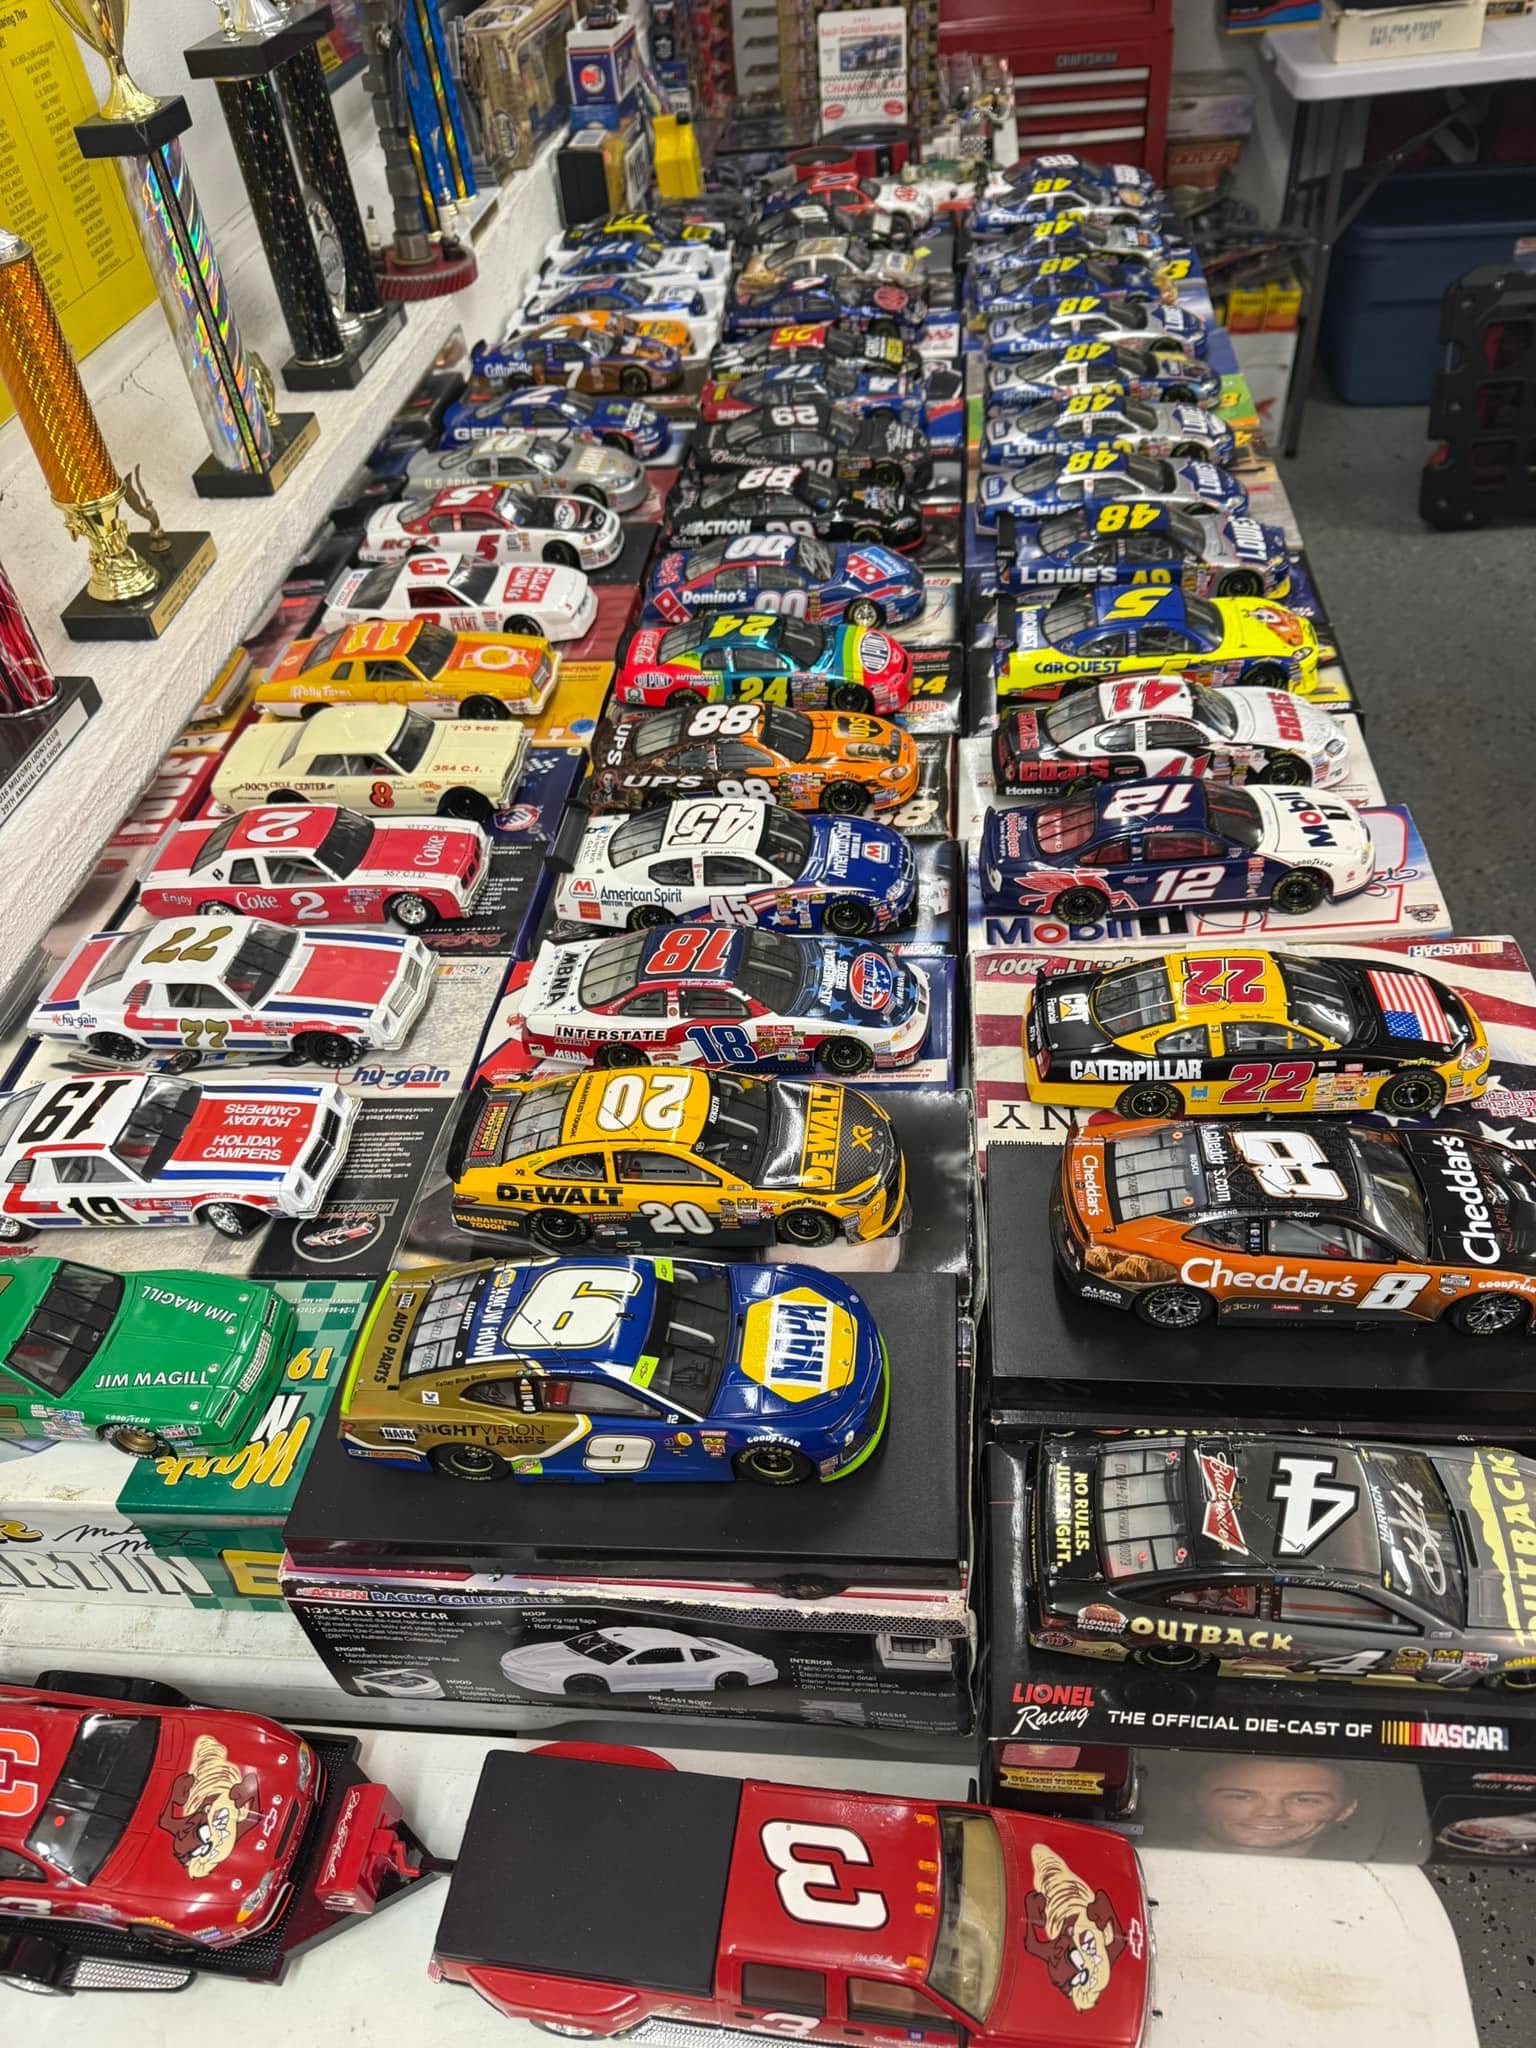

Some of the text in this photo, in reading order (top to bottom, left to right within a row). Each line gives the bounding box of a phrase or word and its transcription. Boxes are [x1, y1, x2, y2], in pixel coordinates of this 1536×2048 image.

[1032, 177, 1072, 194] 48
[1033, 219, 1076, 239] 48
[1038, 256, 1083, 276] 48
[1056, 296, 1102, 315] 48
[1063, 343, 1112, 363] 48
[563, 361, 585, 390] 7
[1066, 394, 1118, 414] 48
[1067, 451, 1121, 474] 48
[1095, 503, 1162, 533] 48
[475, 534, 501, 562] 5
[724, 534, 797, 559] 00
[1019, 566, 1118, 585] LOWE'S
[681, 590, 748, 604] Domino's
[1103, 587, 1173, 620] 5
[344, 621, 412, 654] 11
[707, 614, 778, 639] 24
[739, 677, 789, 708] 24
[1110, 678, 1182, 716] 41
[687, 704, 761, 737] 88
[7, 727, 60, 790] MILFORD LIONS CLUB
[15, 757, 50, 798] ANNUAL CAR
[244, 782, 270, 792] DOC'S
[294, 782, 328, 791] CENTER
[622, 774, 705, 789] UPS
[369, 780, 396, 809] 8
[1102, 783, 1195, 820] 12
[245, 810, 314, 844] 2
[667, 803, 759, 847] 45
[1275, 791, 1340, 850] Mobil
[413, 834, 448, 867] Coke
[600, 887, 683, 904] American Spirit
[1150, 864, 1228, 904] 12
[161, 892, 193, 907] Enjoy
[234, 890, 279, 912] Coke
[289, 891, 330, 921] 2
[708, 895, 758, 925] 45
[140, 925, 236, 965] 77
[985, 916, 1134, 948] Mobil
[646, 927, 738, 975] 18
[1407, 943, 1475, 958] NASCAR
[548, 951, 574, 1008] MBNA
[836, 958, 848, 993] HEROES
[986, 957, 1050, 978] 2001
[1182, 957, 1266, 1007] 22
[862, 956, 875, 1011] LET'S ROLL
[61, 1012, 98, 1028] hy-gain
[178, 1017, 231, 1048] 77
[555, 1027, 667, 1042] INTERSTATE
[684, 1024, 759, 1065] 18
[352, 1065, 452, 1087] hy-gain
[1069, 1058, 1204, 1082] CATERPILLAR
[1220, 1061, 1316, 1105] 22
[17, 1079, 131, 1144] 19
[224, 1103, 302, 1118] CAMPERS
[596, 1073, 695, 1132] 20
[221, 1115, 293, 1129] HOLIDAY
[201, 1146, 283, 1161] CAMPERS
[212, 1134, 283, 1147] HOLIDAY
[1230, 1131, 1350, 1202] 8
[1081, 1153, 1104, 1217] Cheddar's
[1432, 1134, 1502, 1266] Cheddar's
[67, 1196, 142, 1226] 19
[636, 1200, 716, 1236] 20
[781, 1198, 829, 1210] GOODYEAR
[455, 1214, 520, 1228] GUARANTEED
[469, 1222, 509, 1232] TOUGH.
[1179, 1256, 1360, 1299] Cheddar's
[1356, 1272, 1432, 1310] 8
[140, 1285, 239, 1324] JIM MAGILL
[461, 1301, 477, 1331] ELLIOTT
[502, 1264, 642, 1350] 9
[373, 1312, 410, 1385] AUTO PARTS
[473, 1326, 500, 1358] HOW
[770, 1303, 828, 1384] NAPA
[287, 1346, 336, 1381] 19
[94, 1370, 211, 1389] JIM MAGILL
[105, 1413, 152, 1424] GOODYEAR
[665, 1414, 680, 1424] 12
[379, 1427, 417, 1443] NAPA
[485, 1435, 547, 1447] LAMPS
[746, 1433, 802, 1449] GOODYEAR
[844, 1429, 856, 1448] 9
[155, 1415, 313, 1490] Mark
[582, 1434, 655, 1474] 9
[1054, 1463, 1073, 1568] JUST RIGHT.
[1073, 1470, 1091, 1557] NO RULES.
[1273, 1455, 1358, 1557] 4
[1371, 1484, 1391, 1544] HARVICK
[309, 1587, 440, 1606] ACTION RACING
[303, 1605, 450, 1621] 1:24-SCALE STOCK CAR
[1130, 1615, 1293, 1652] OUTBACK
[789, 1657, 834, 1667] INTERIOR
[1300, 1649, 1391, 1676] 4
[1011, 1683, 1095, 1707] LIONEL
[1010, 1705, 1090, 1736] Racing
[1107, 1709, 1374, 1739] THE OFFICIAL DIE-CAST OF
[1420, 1725, 1505, 1752] NASCAR
[1010, 1775, 1053, 1785] GOLDEN
[1055, 1777, 1095, 1788] TICKET
[759, 1818, 890, 1933] 3
